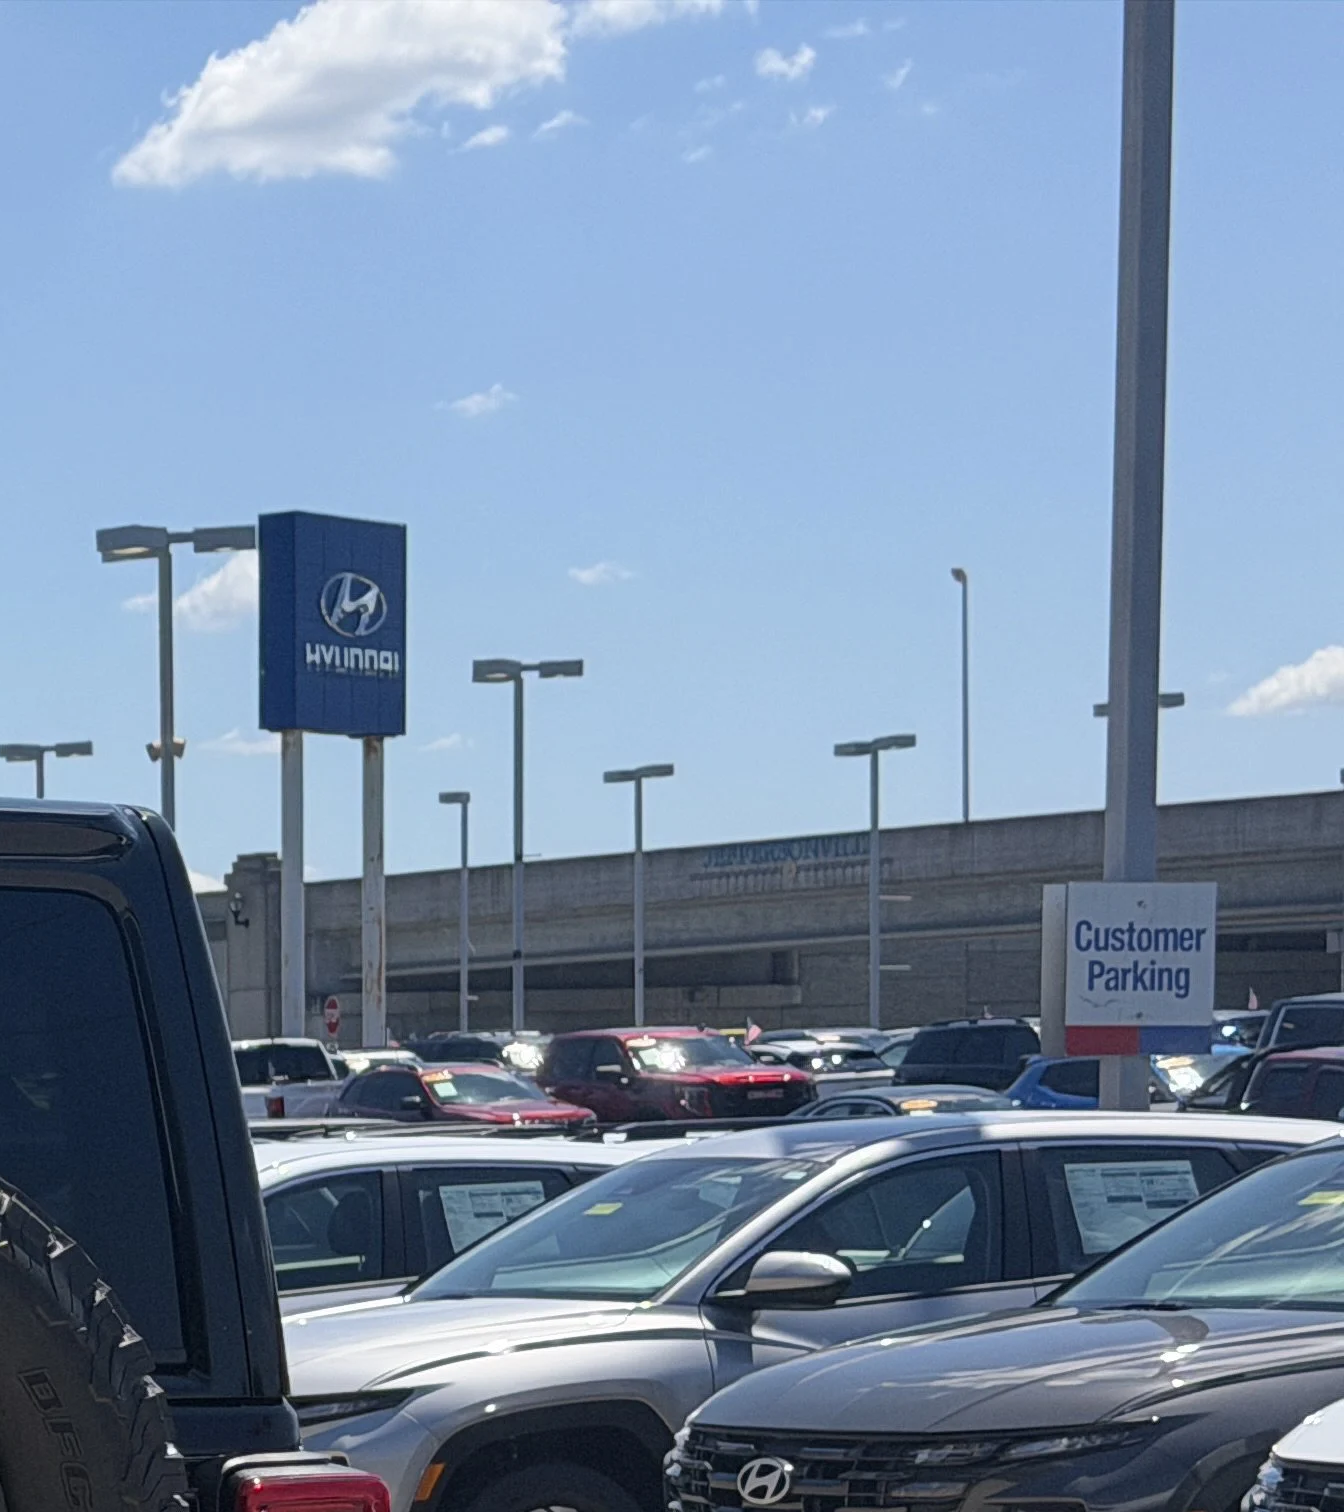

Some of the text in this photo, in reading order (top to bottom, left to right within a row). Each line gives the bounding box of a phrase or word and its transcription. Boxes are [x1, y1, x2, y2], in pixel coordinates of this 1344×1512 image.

[305, 642, 399, 673] HYUNDAI
[1074, 919, 1208, 953] Customer
[1087, 959, 1191, 999] Parking
